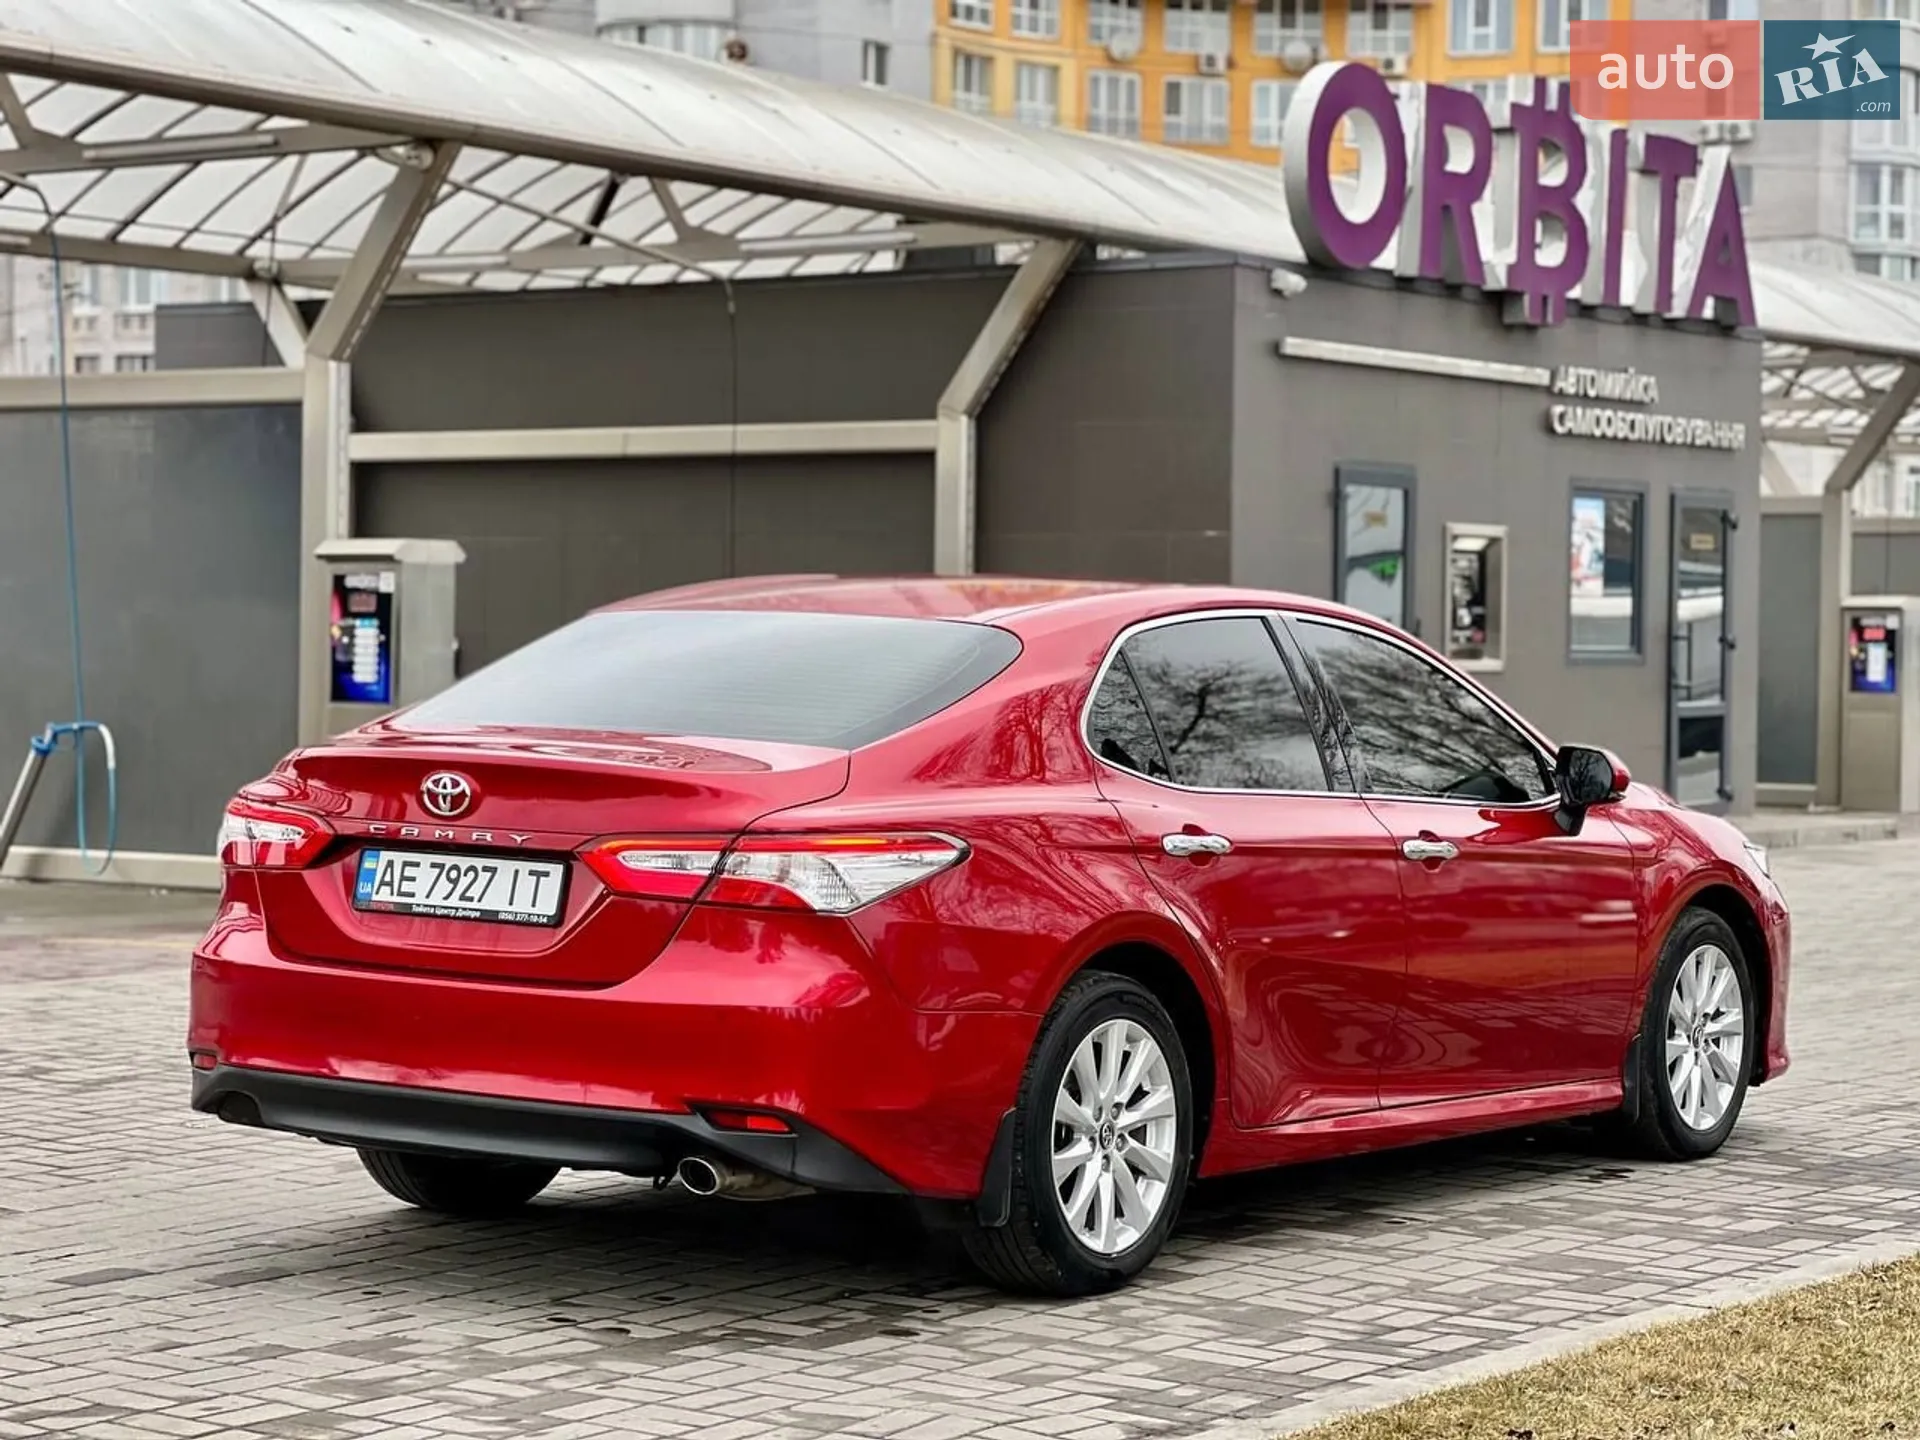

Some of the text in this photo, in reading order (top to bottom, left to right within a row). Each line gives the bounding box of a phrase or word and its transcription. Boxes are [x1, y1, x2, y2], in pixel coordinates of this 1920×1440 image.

[1553, 365, 1660, 405] АВТОМИЙКА
[1551, 404, 1747, 450] САМООБСЛУГОВУВАННЯ
[368, 824, 533, 845] CAMRY
[358, 881, 372, 894] UA
[374, 859, 551, 909] AE 7927 IT
